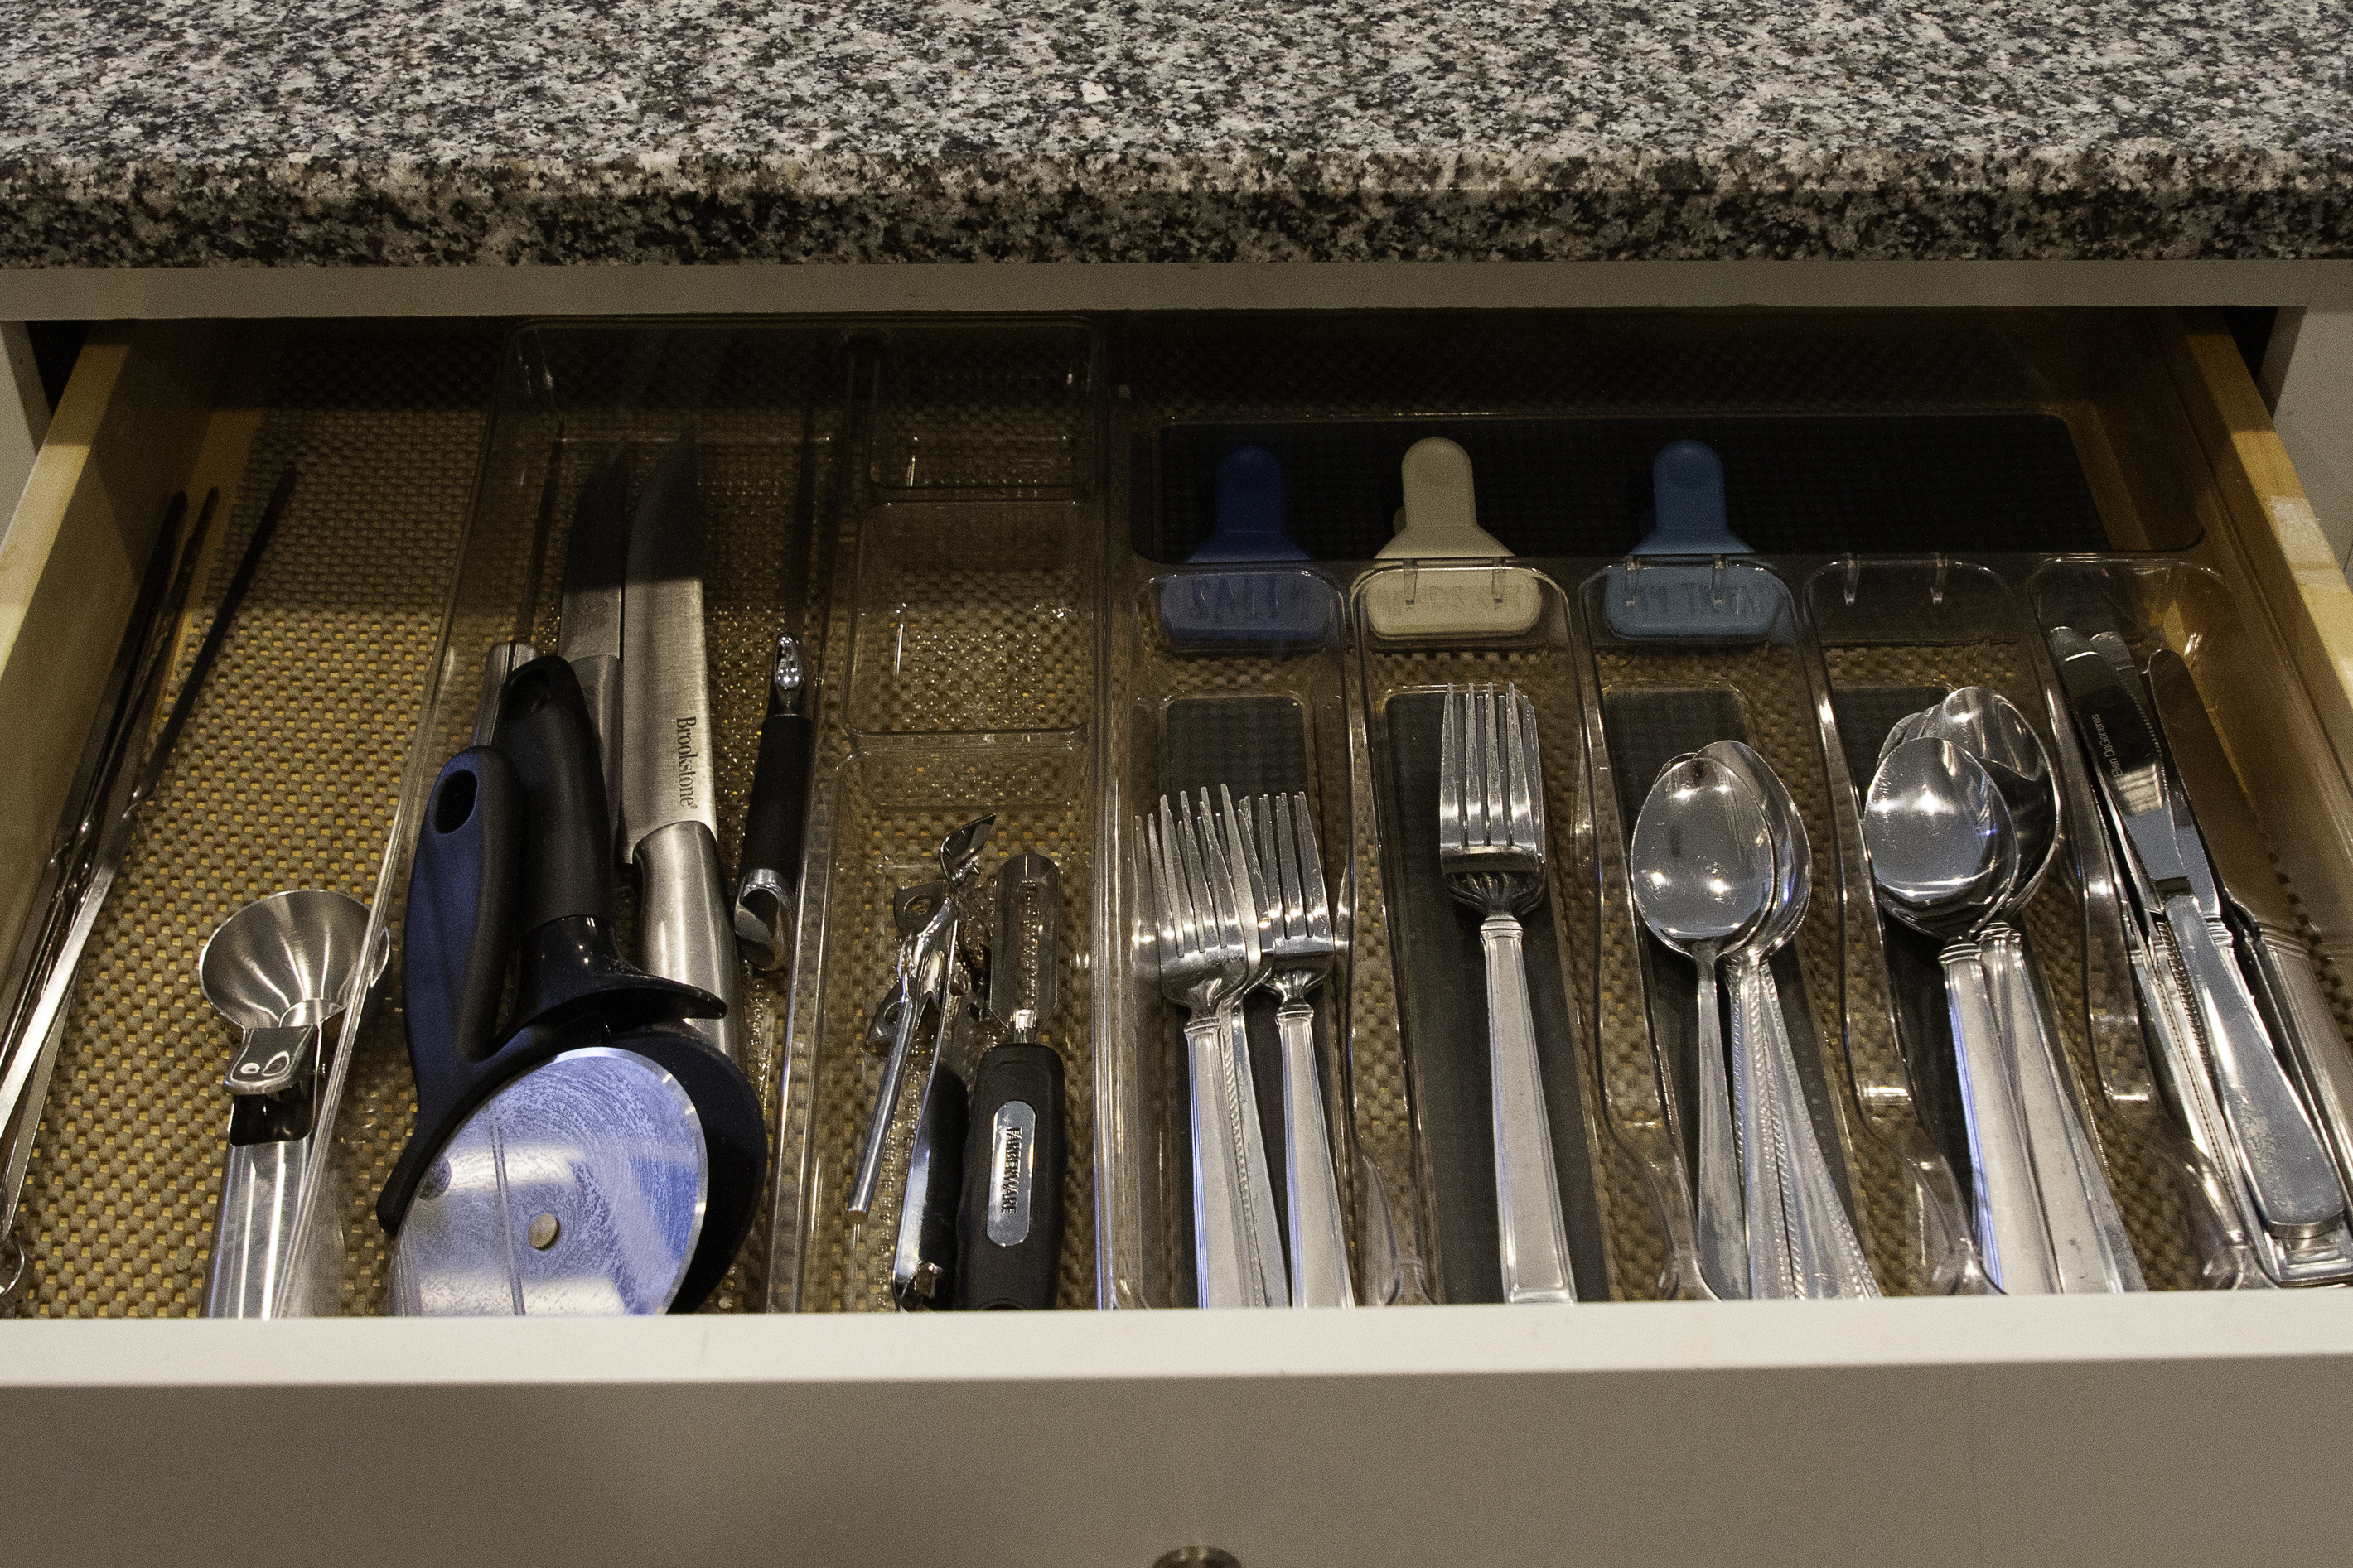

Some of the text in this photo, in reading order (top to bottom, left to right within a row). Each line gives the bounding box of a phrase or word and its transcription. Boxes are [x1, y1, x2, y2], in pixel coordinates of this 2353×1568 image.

[2091, 713, 2123, 778] Ellen DeGeneres
[1001, 1127, 1022, 1214] FARBERWARE
